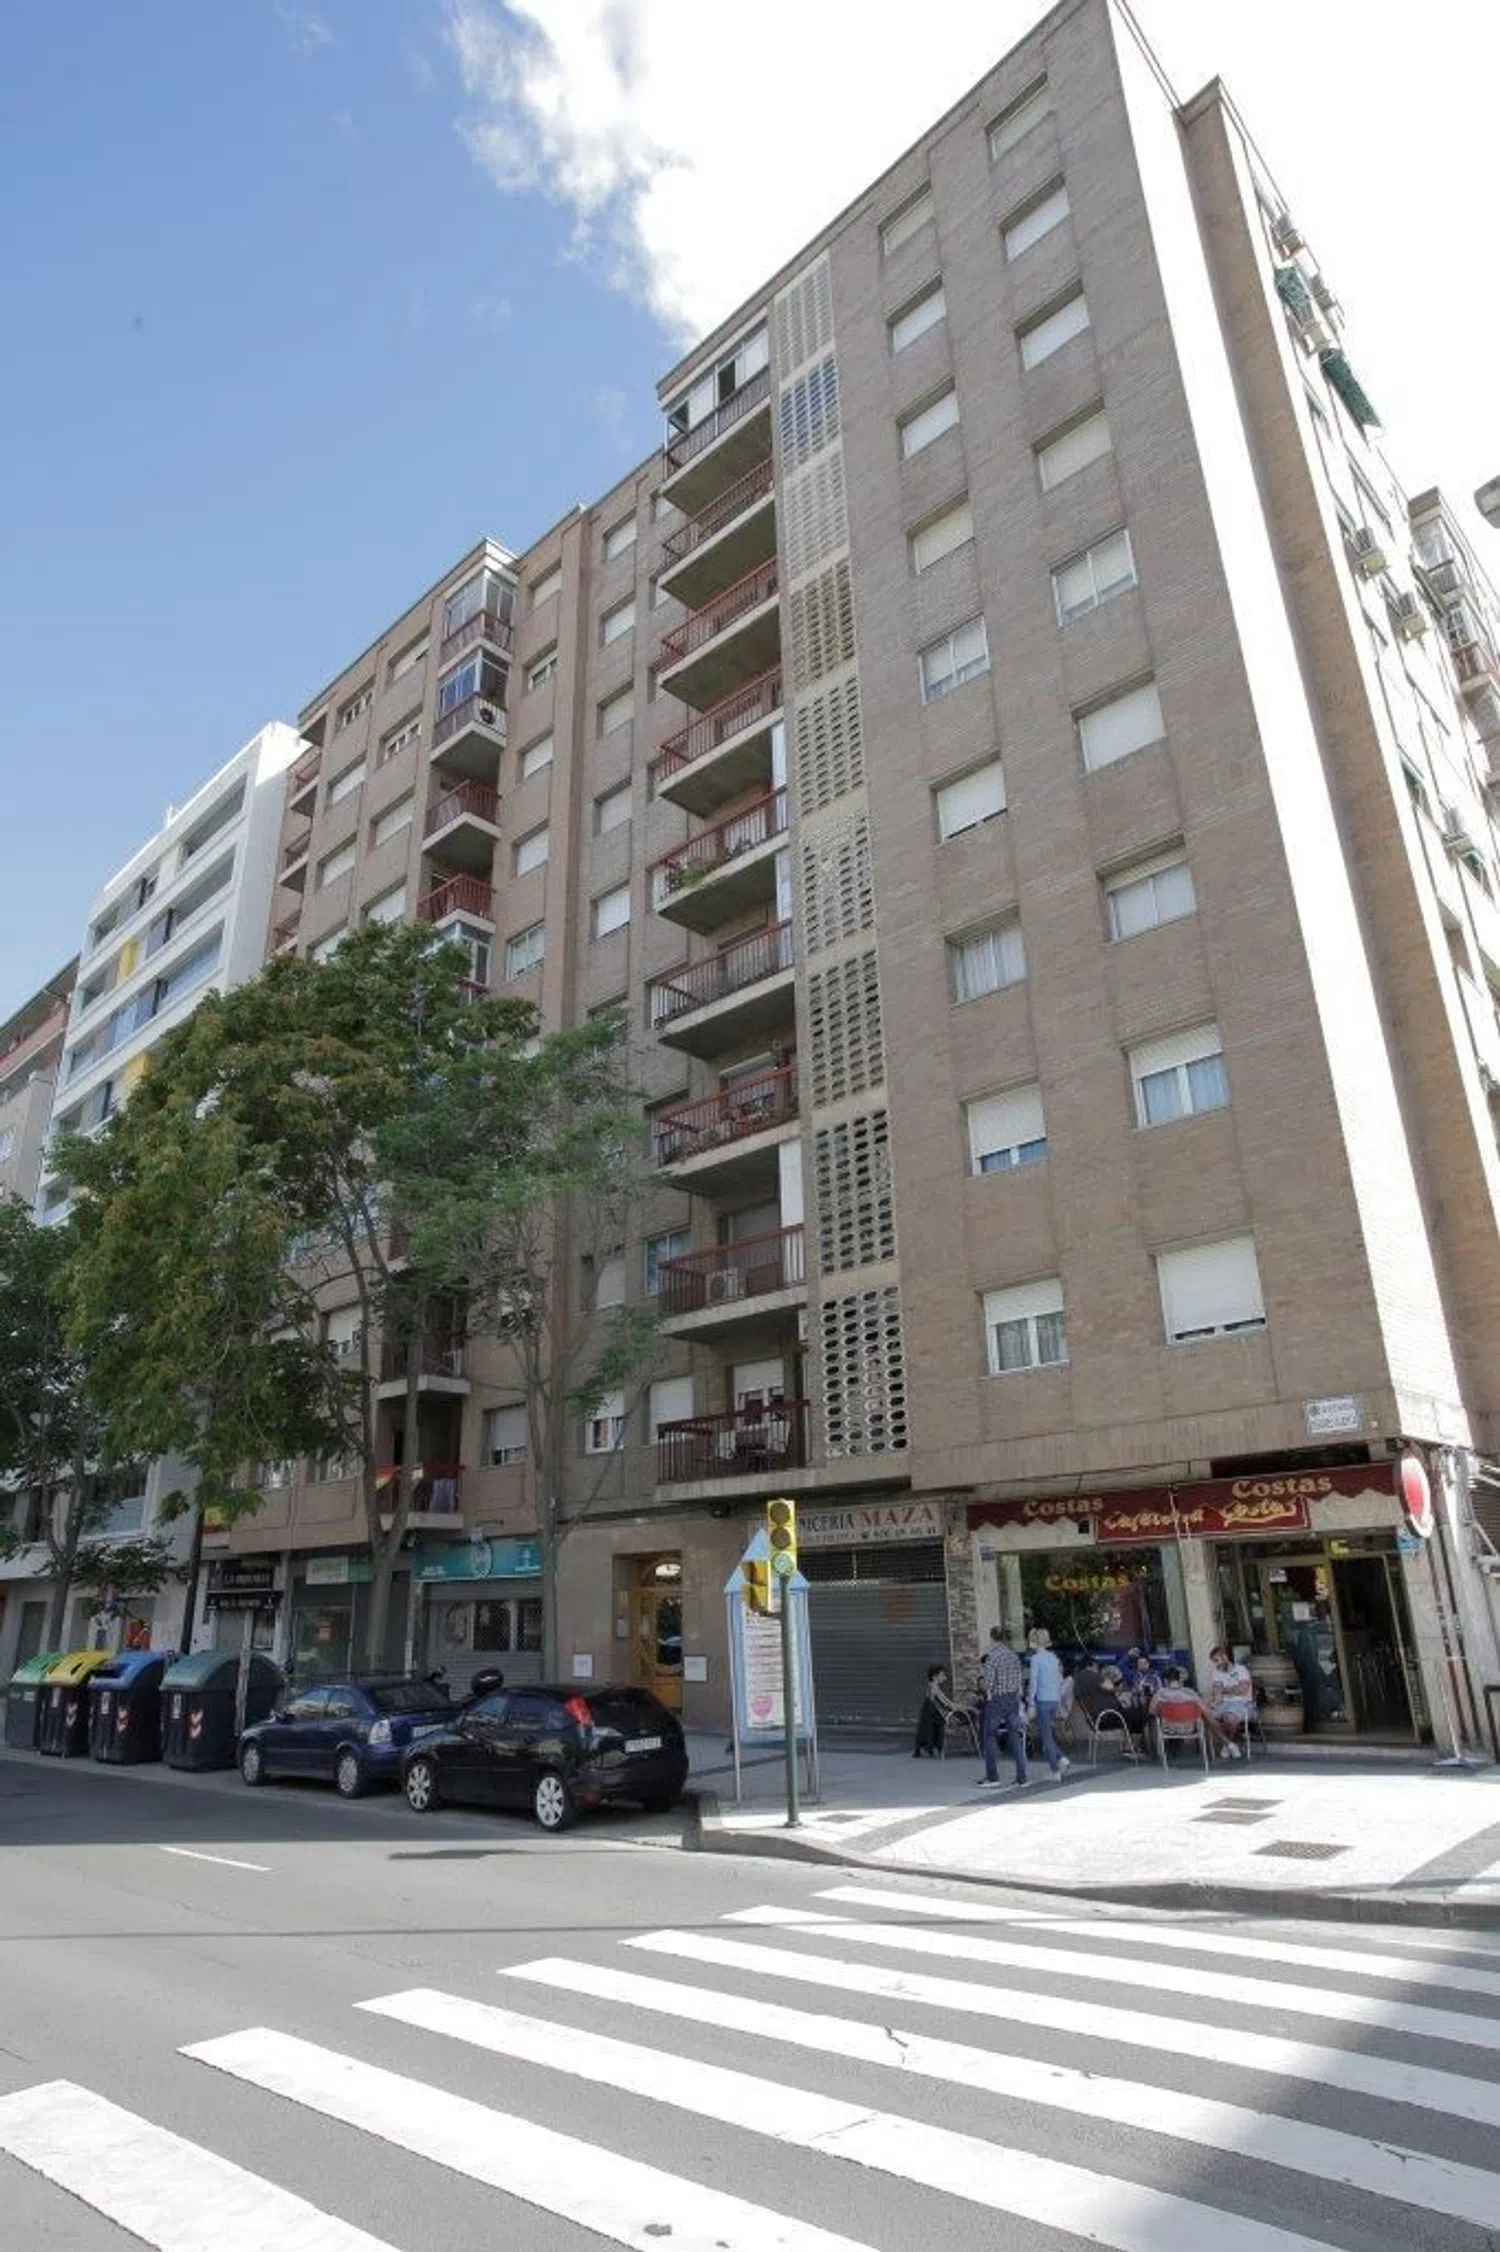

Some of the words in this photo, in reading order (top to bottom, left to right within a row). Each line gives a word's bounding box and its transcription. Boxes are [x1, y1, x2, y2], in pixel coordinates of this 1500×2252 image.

[1231, 1475, 1333, 1499] Costas
[861, 1504, 936, 1528] MAZA
[1022, 1498, 1104, 1517] Costas
[1044, 1573, 1130, 1591] Costas
